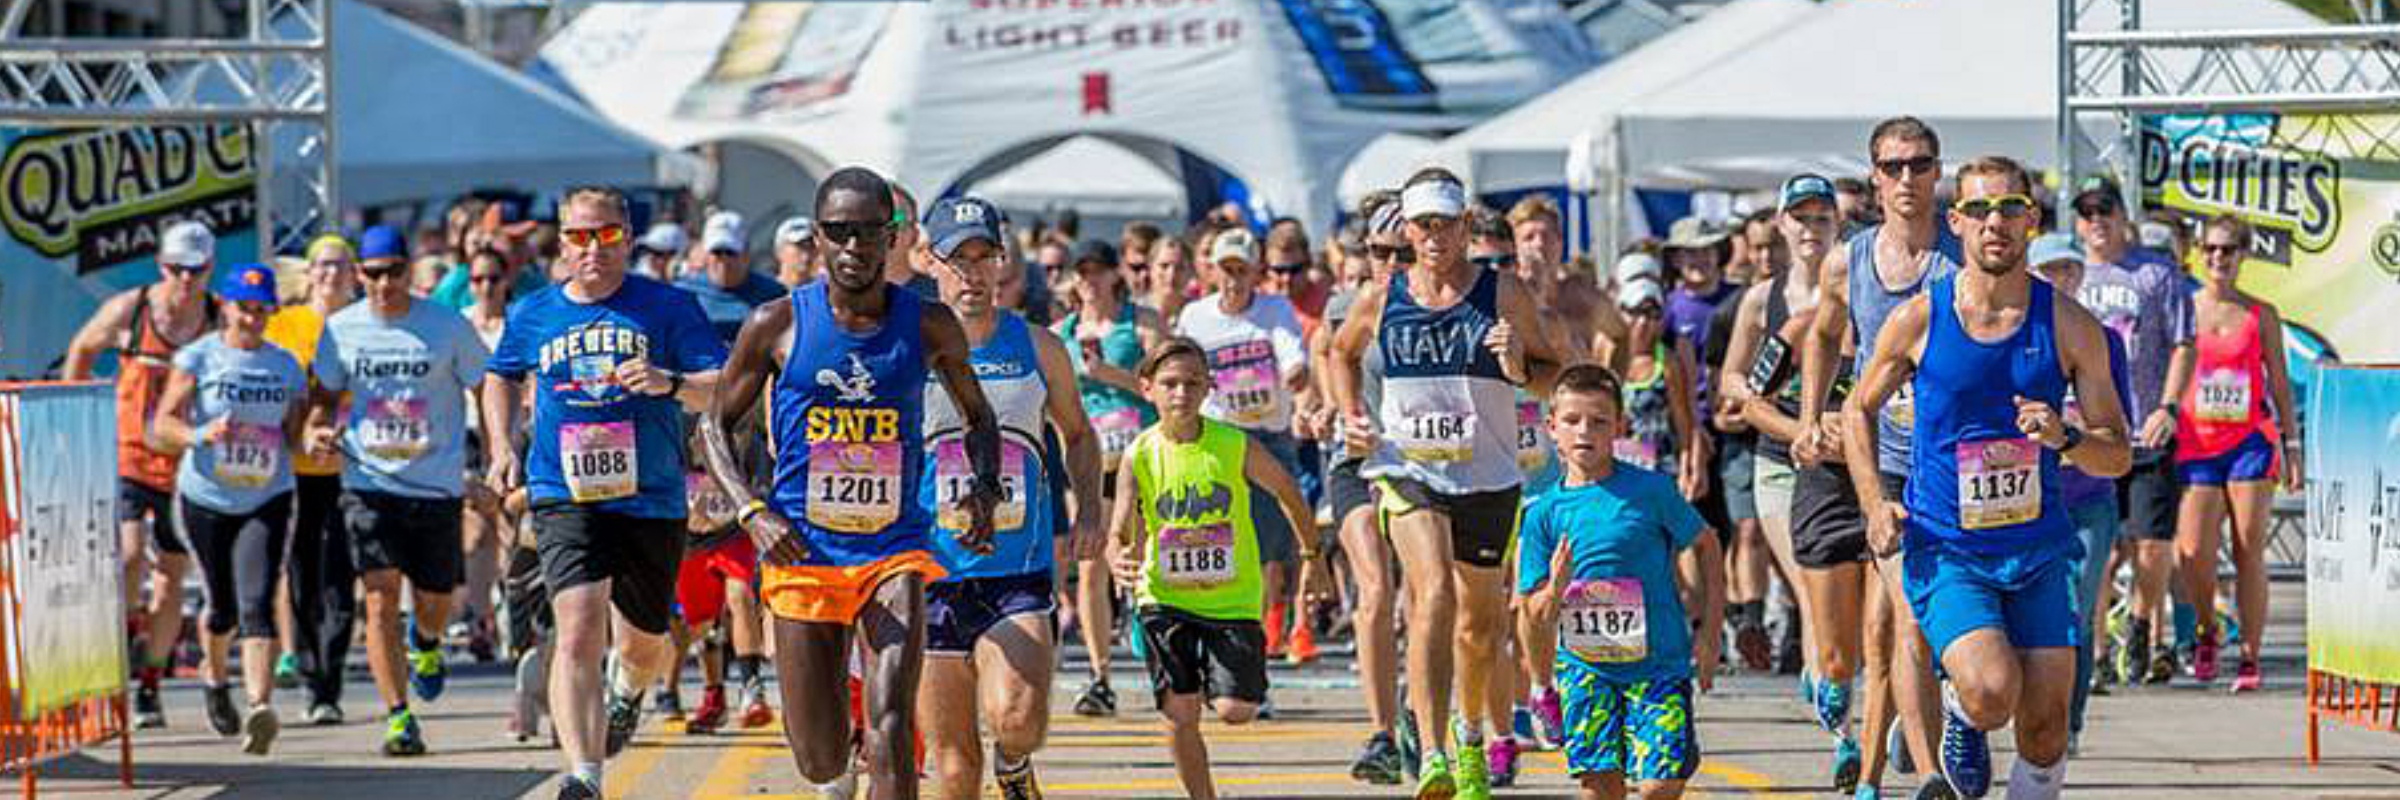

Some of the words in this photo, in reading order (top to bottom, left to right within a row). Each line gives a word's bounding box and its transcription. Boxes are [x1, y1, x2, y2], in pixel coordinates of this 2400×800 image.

[946, 23, 1089, 47] LIGHT
[1112, 19, 1240, 44] BEER
[8, 126, 197, 237] QUAD
[2179, 142, 2330, 236] CITIES
[1387, 321, 1486, 367] NAVY
[355, 357, 430, 378] Reno
[805, 405, 899, 442] SNB
[1412, 416, 1465, 439] 1164
[571, 450, 628, 477] 1088
[821, 474, 890, 505] 1201
[1970, 469, 2030, 501] 1137
[1170, 547, 1227, 573] 1188
[1573, 610, 1635, 636] 1187
